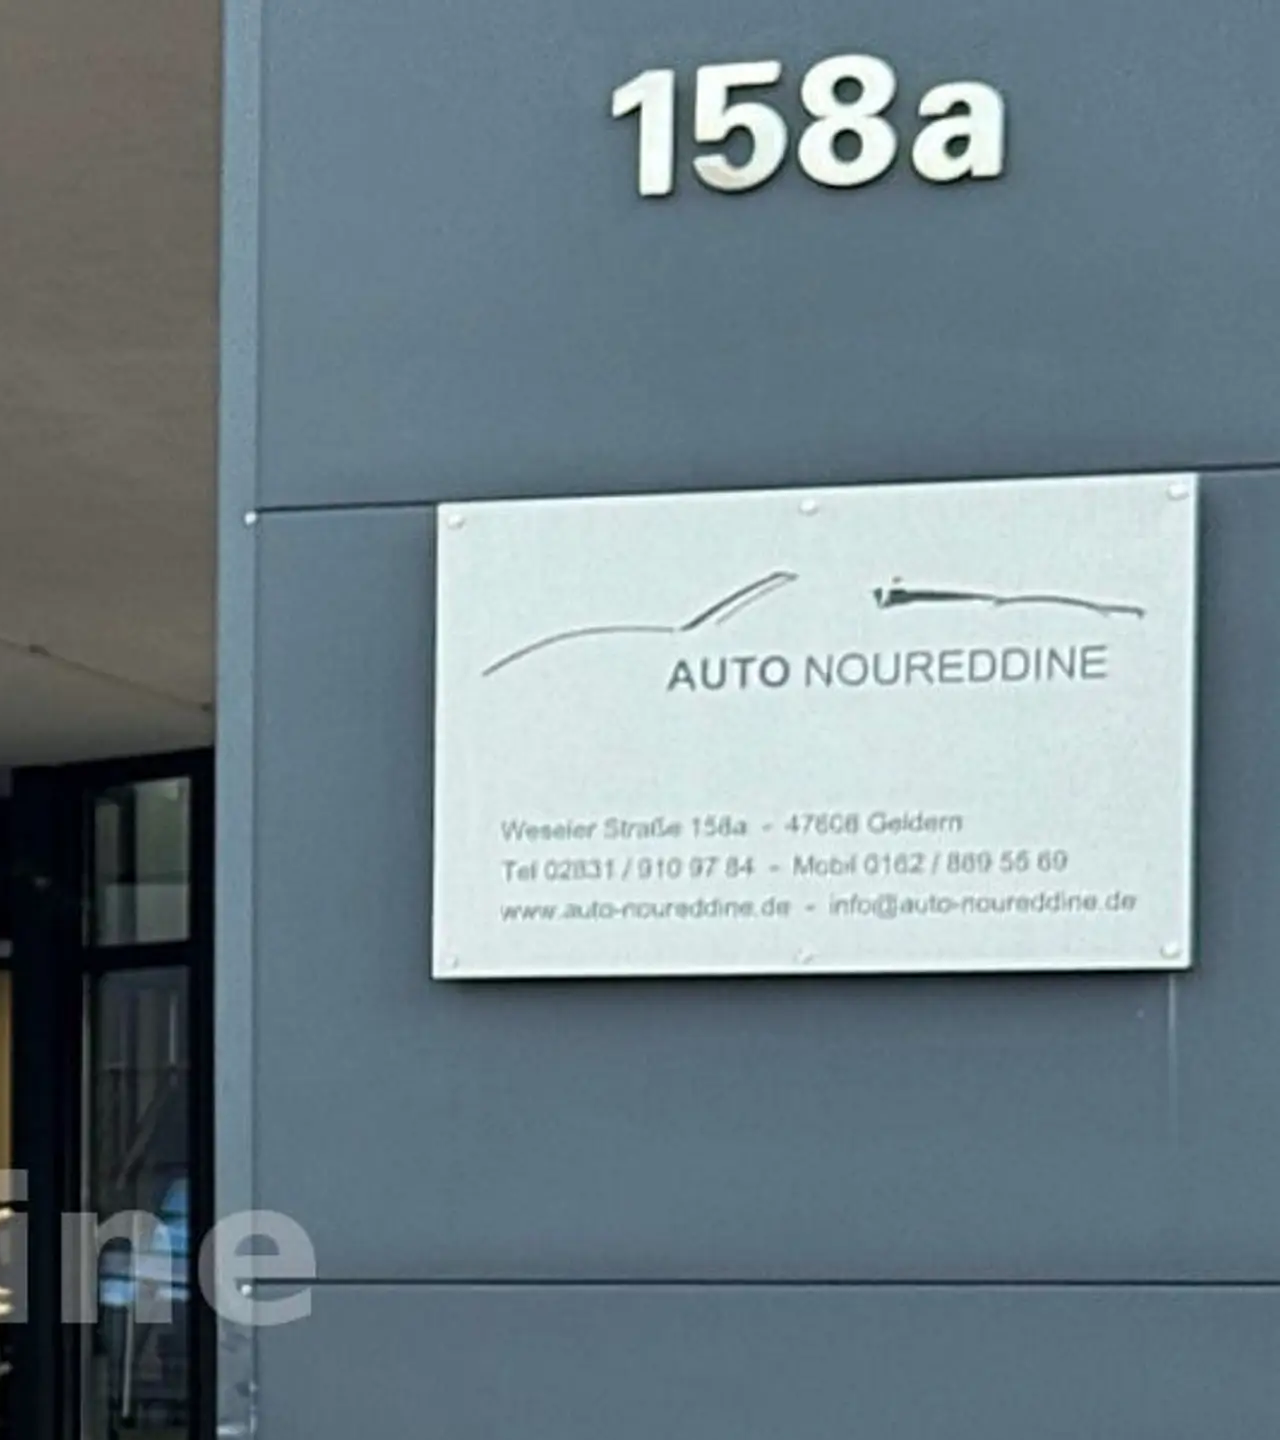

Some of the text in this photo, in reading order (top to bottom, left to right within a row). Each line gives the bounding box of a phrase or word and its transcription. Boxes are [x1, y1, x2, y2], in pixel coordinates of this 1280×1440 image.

[611, 53, 1006, 197] 158a
[667, 644, 1109, 692] AUTO NOUREDDINE
[603, 815, 683, 840] Straße
[866, 809, 965, 835] Geldern
[501, 857, 537, 883] Tel
[792, 852, 857, 878] Mobil
[500, 894, 792, 921] www.auto-noureddine.de
[828, 889, 1138, 920] info@auto-noureddine.de
